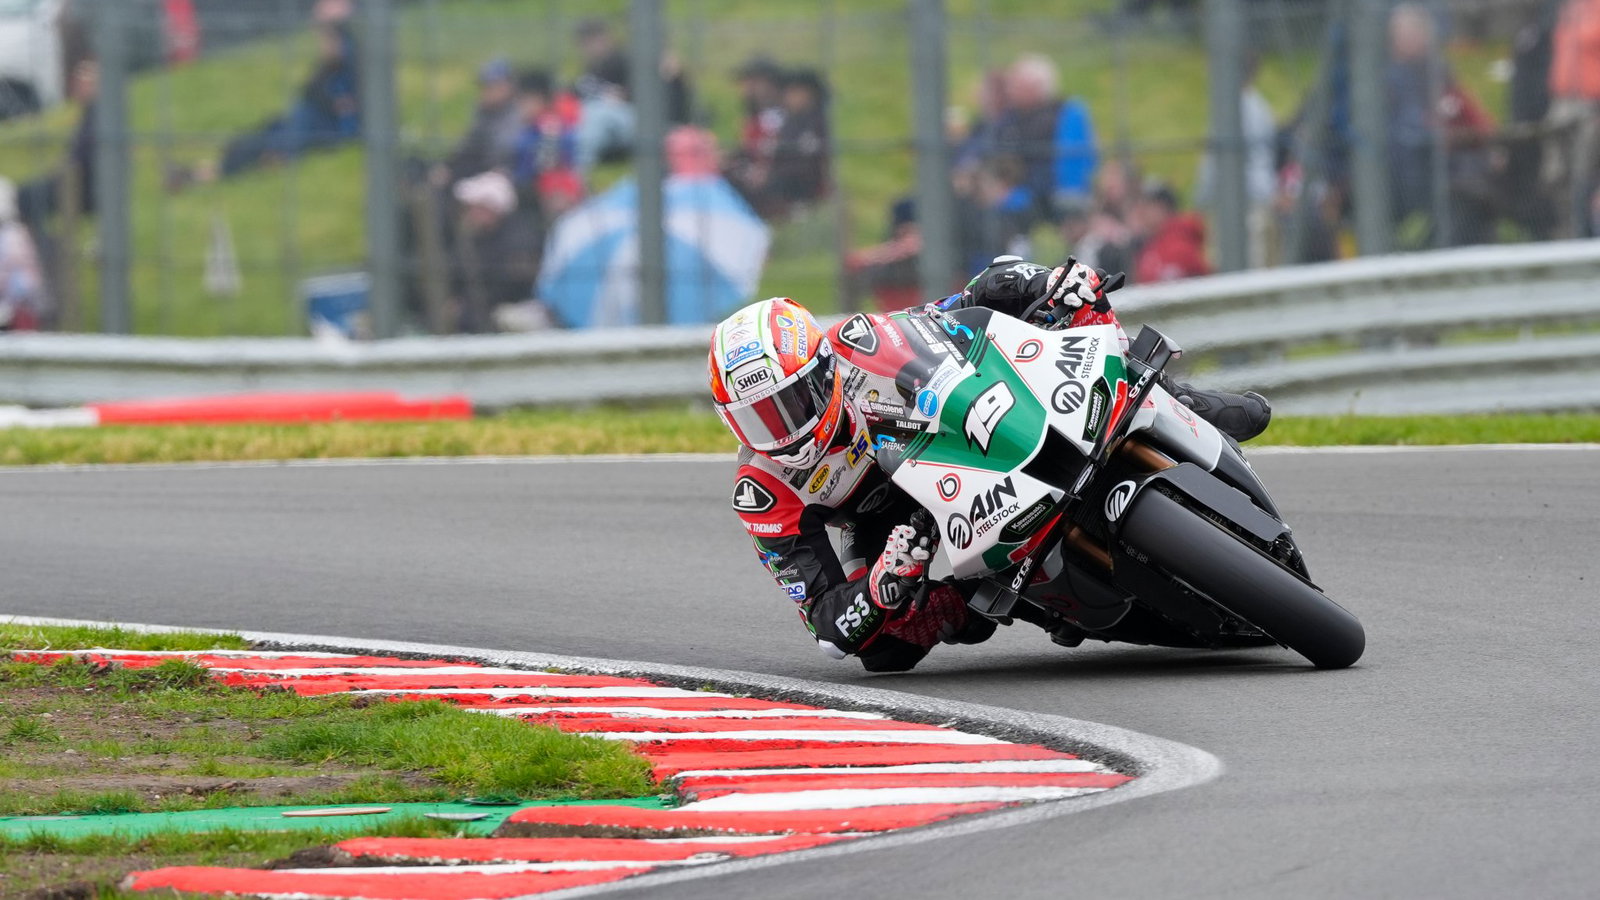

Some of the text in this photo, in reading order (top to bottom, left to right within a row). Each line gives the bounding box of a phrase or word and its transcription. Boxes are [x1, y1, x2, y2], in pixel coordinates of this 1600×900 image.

[1055, 336, 1088, 379] AJN
[1081, 337, 1101, 379] STEELSTOCK
[737, 369, 769, 390] SHOEI
[739, 384, 781, 406] ROBINSONS
[896, 420, 922, 430] TALBOT
[963, 380, 1015, 453] 19
[881, 441, 906, 452] SAFEPAC
[969, 475, 1018, 527] AJN
[753, 523, 783, 533] THOMAS
[976, 502, 1021, 538] STEELSTOCK
[835, 592, 870, 638] FS3
[849, 609, 879, 642] RACING
